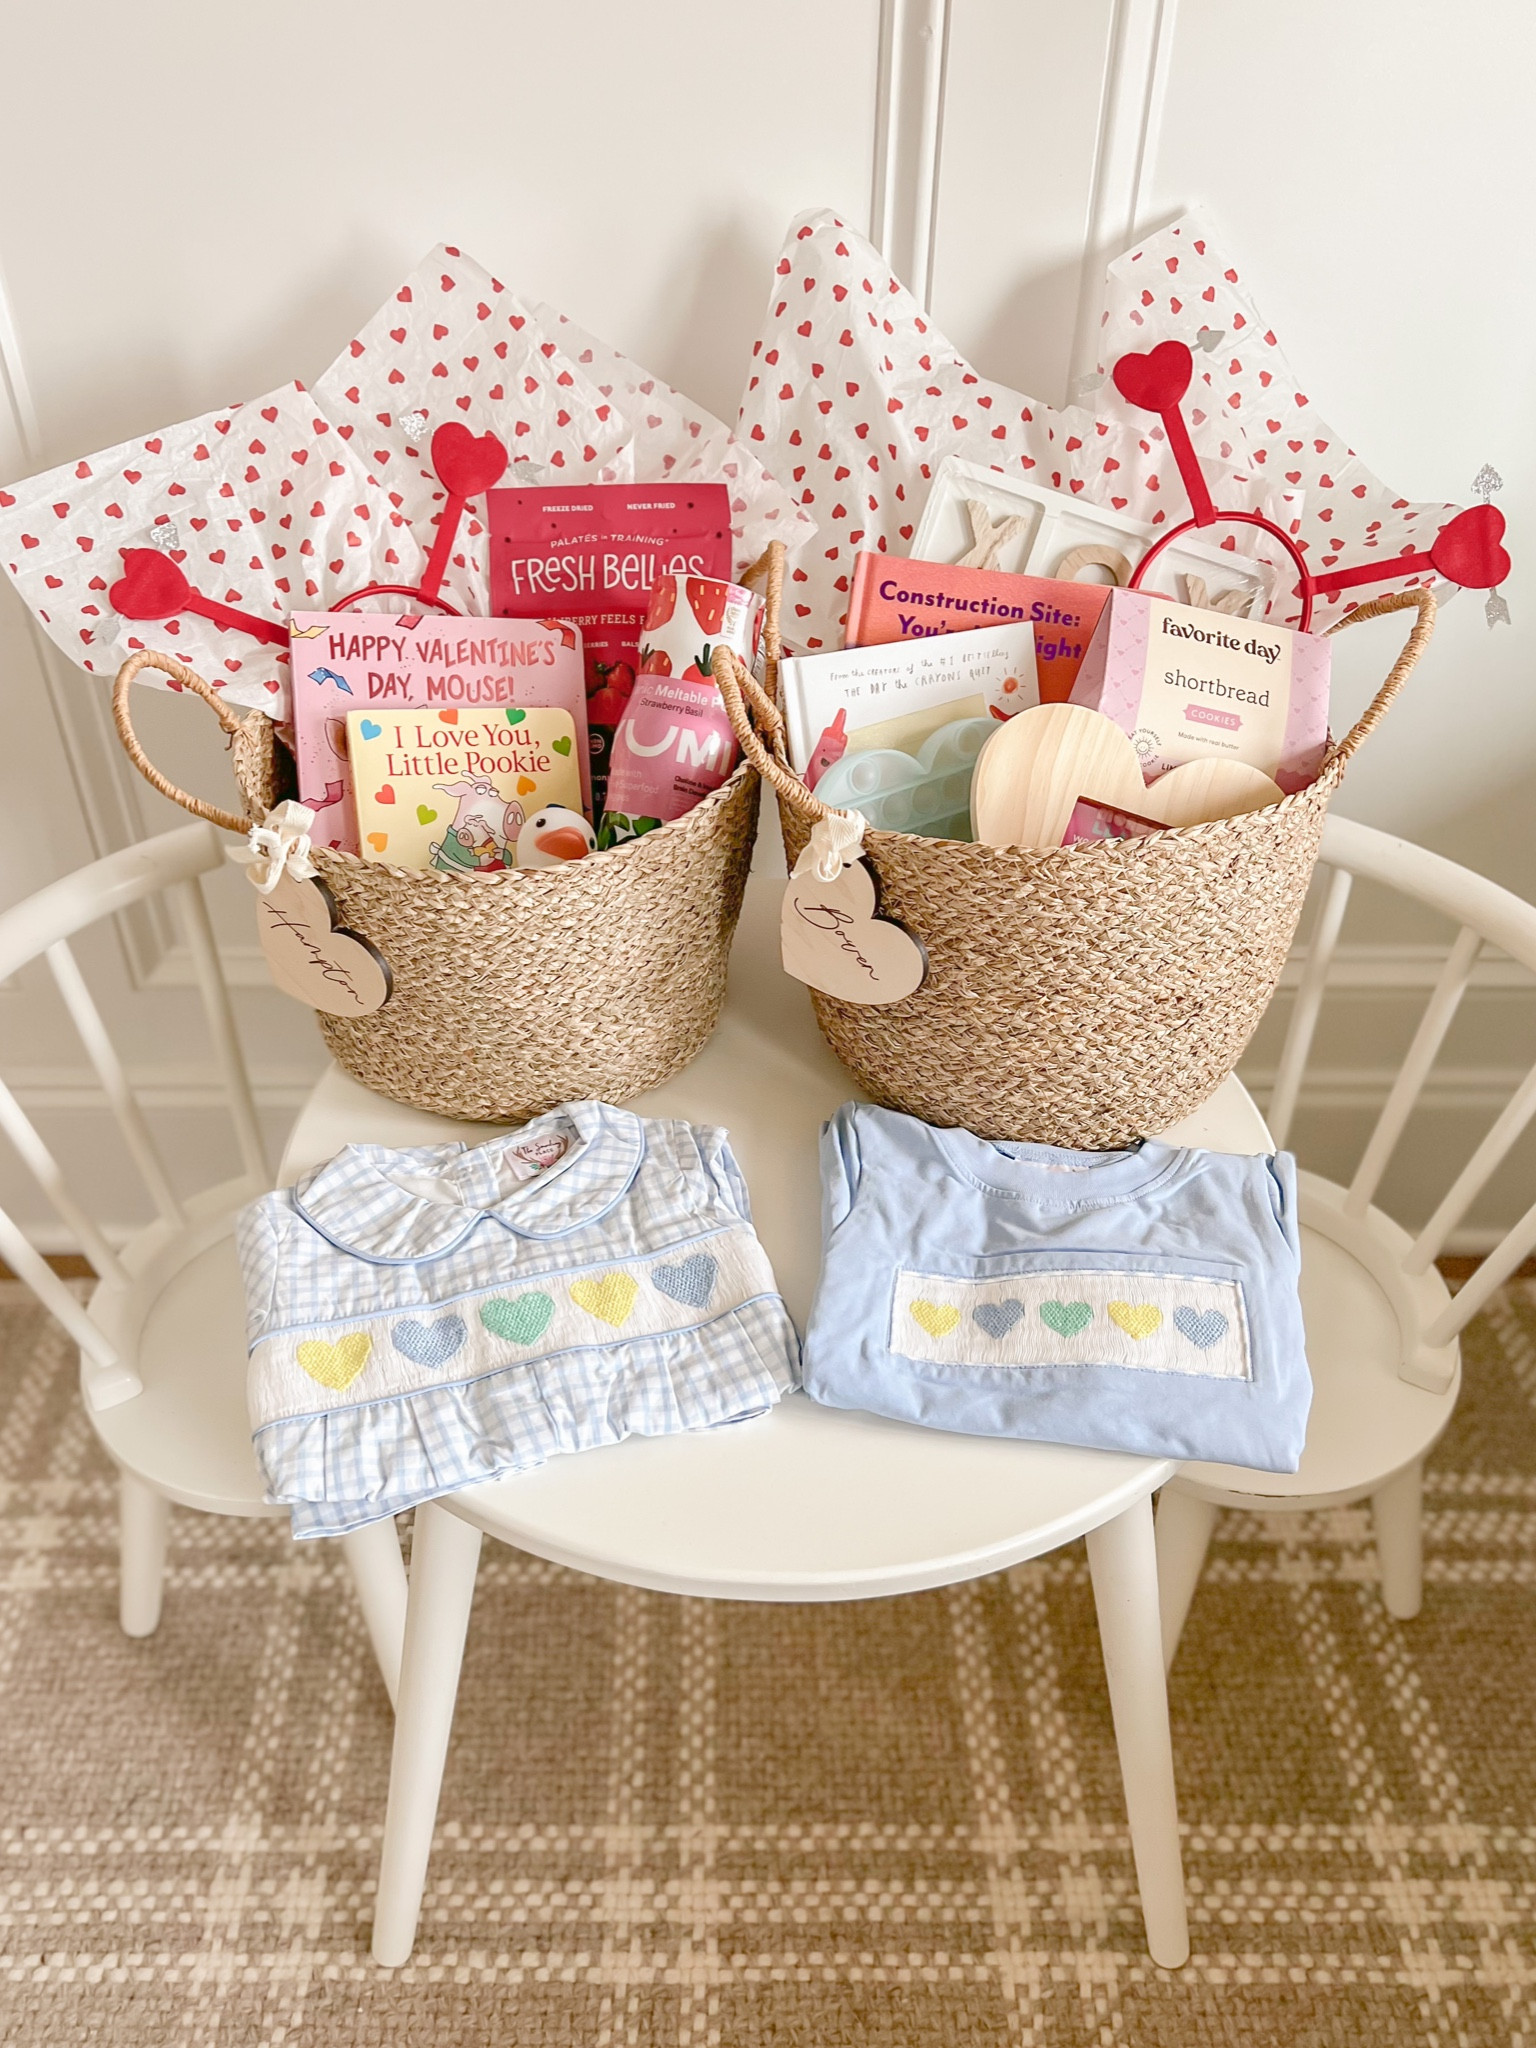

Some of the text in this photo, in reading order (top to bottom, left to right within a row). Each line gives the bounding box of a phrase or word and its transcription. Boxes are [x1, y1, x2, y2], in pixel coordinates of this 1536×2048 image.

[542, 504, 594, 513] FREEZE DRIED
[626, 502, 676, 510] NEVER FRIED
[879, 580, 1082, 628] Construction Site:
[600, 614, 636, 626] FEELS
[328, 632, 556, 668] HAPPY VALENTINE'S
[1036, 635, 1082, 661] ight
[1162, 617, 1281, 664] favorite day
[906, 664, 914, 675] of
[920, 658, 933, 668] the
[368, 672, 516, 704] DAY, MOUSE!
[844, 666, 991, 698] THE DAY the CRAYONS QUIT
[1164, 668, 1270, 708] shortbread
[655, 684, 708, 706] Meltable
[640, 698, 704, 718] Strawberry Basil
[1190, 709, 1236, 727] COOKIES
[393, 724, 541, 750] I Love You,
[1128, 728, 1162, 746] EAT YOURSELF
[1178, 731, 1240, 750] Made with real butter
[387, 750, 552, 777] Little Pookie
